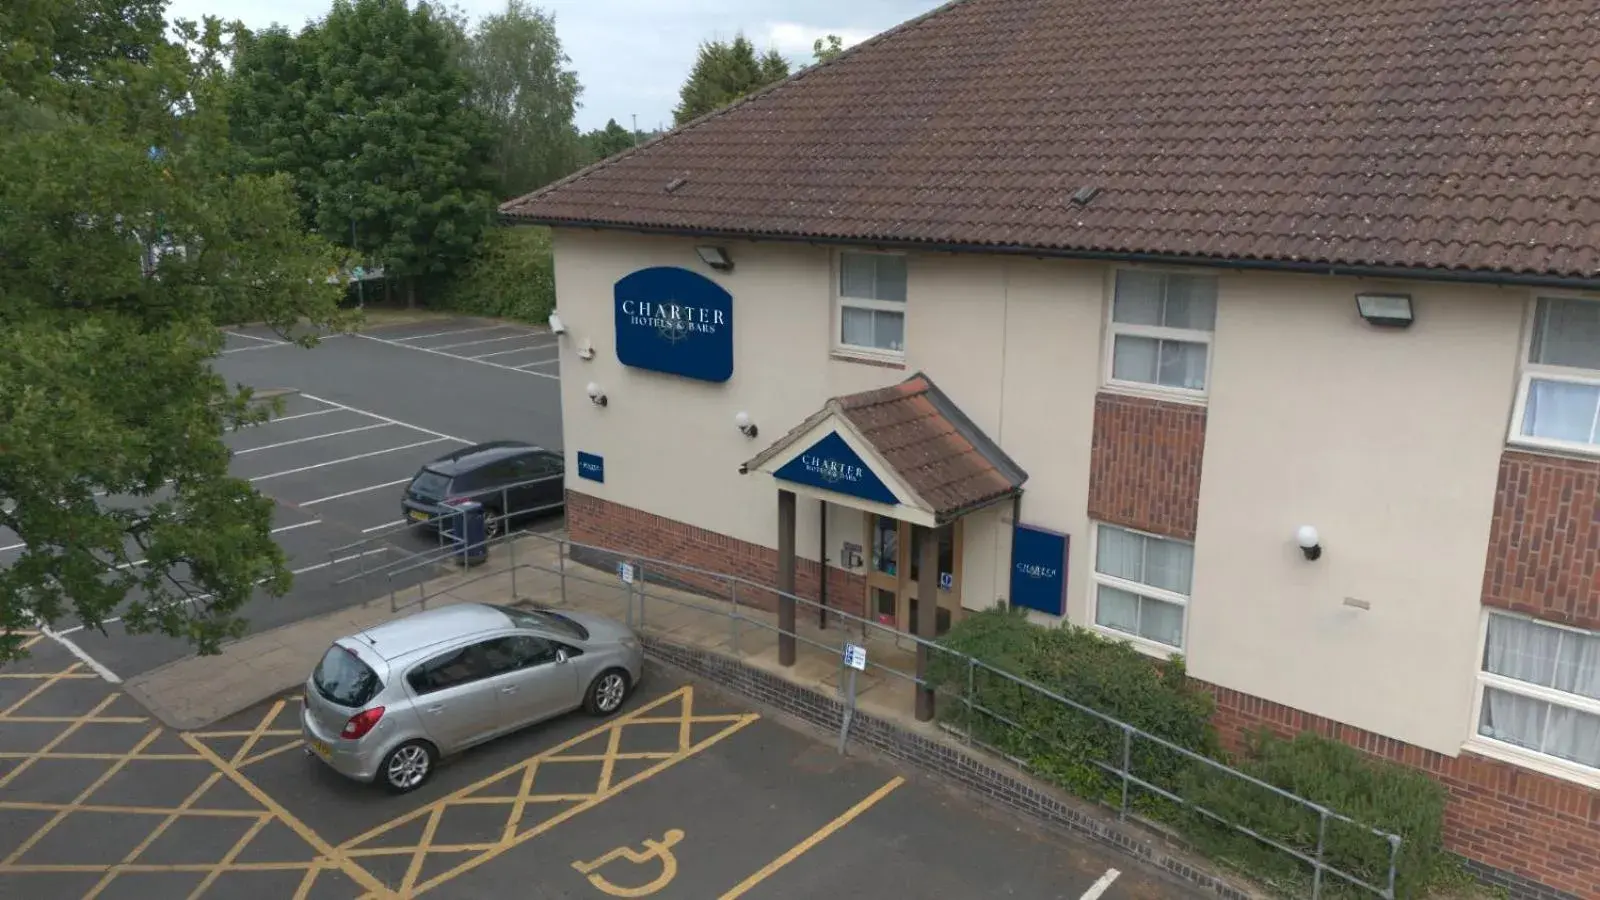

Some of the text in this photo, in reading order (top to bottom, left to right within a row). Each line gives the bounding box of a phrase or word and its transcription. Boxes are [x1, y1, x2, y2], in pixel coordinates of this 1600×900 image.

[622, 300, 724, 325] CHARTER
[631, 315, 715, 333] HOTELS & BARS
[802, 455, 862, 477] CHARTER
